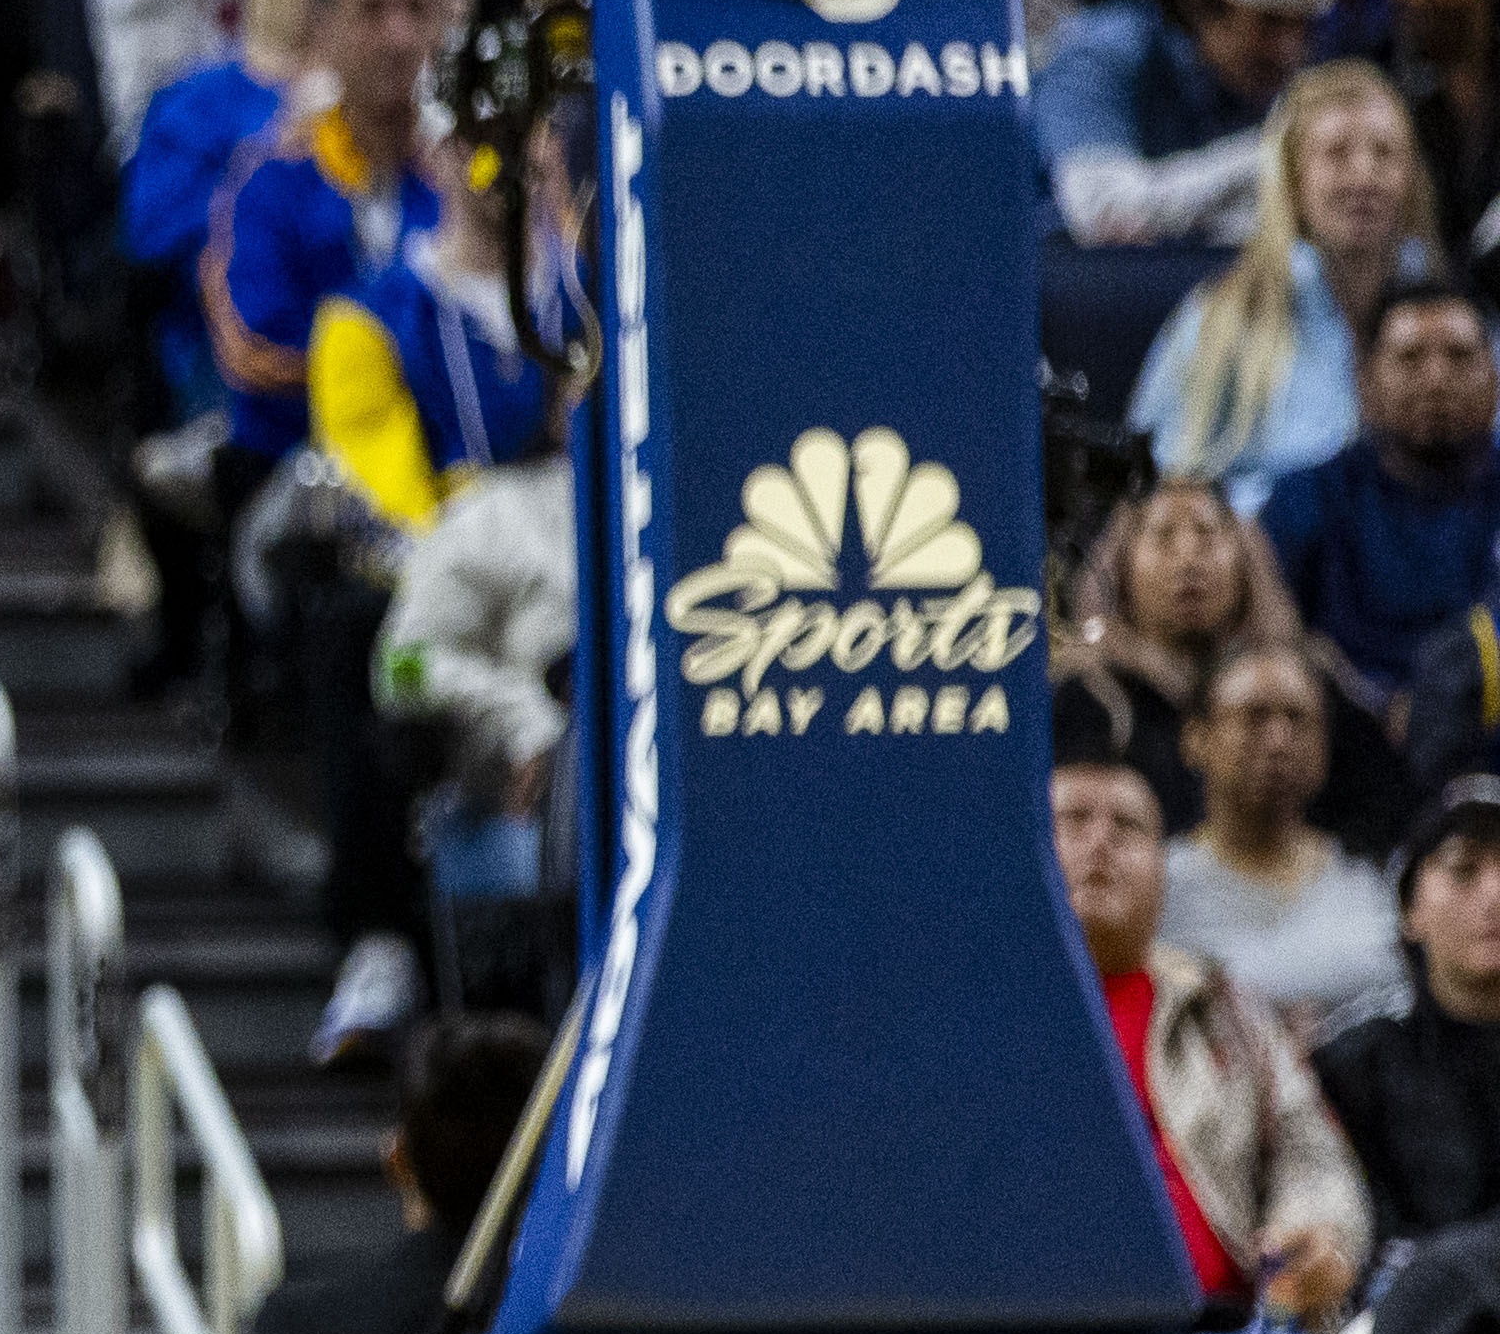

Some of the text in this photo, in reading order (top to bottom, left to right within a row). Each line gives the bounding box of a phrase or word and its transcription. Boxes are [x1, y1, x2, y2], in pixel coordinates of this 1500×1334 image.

[655, 40, 1030, 98] DOORDASH
[664, 563, 1043, 700] Sports
[701, 685, 1011, 737] BAY AREA
